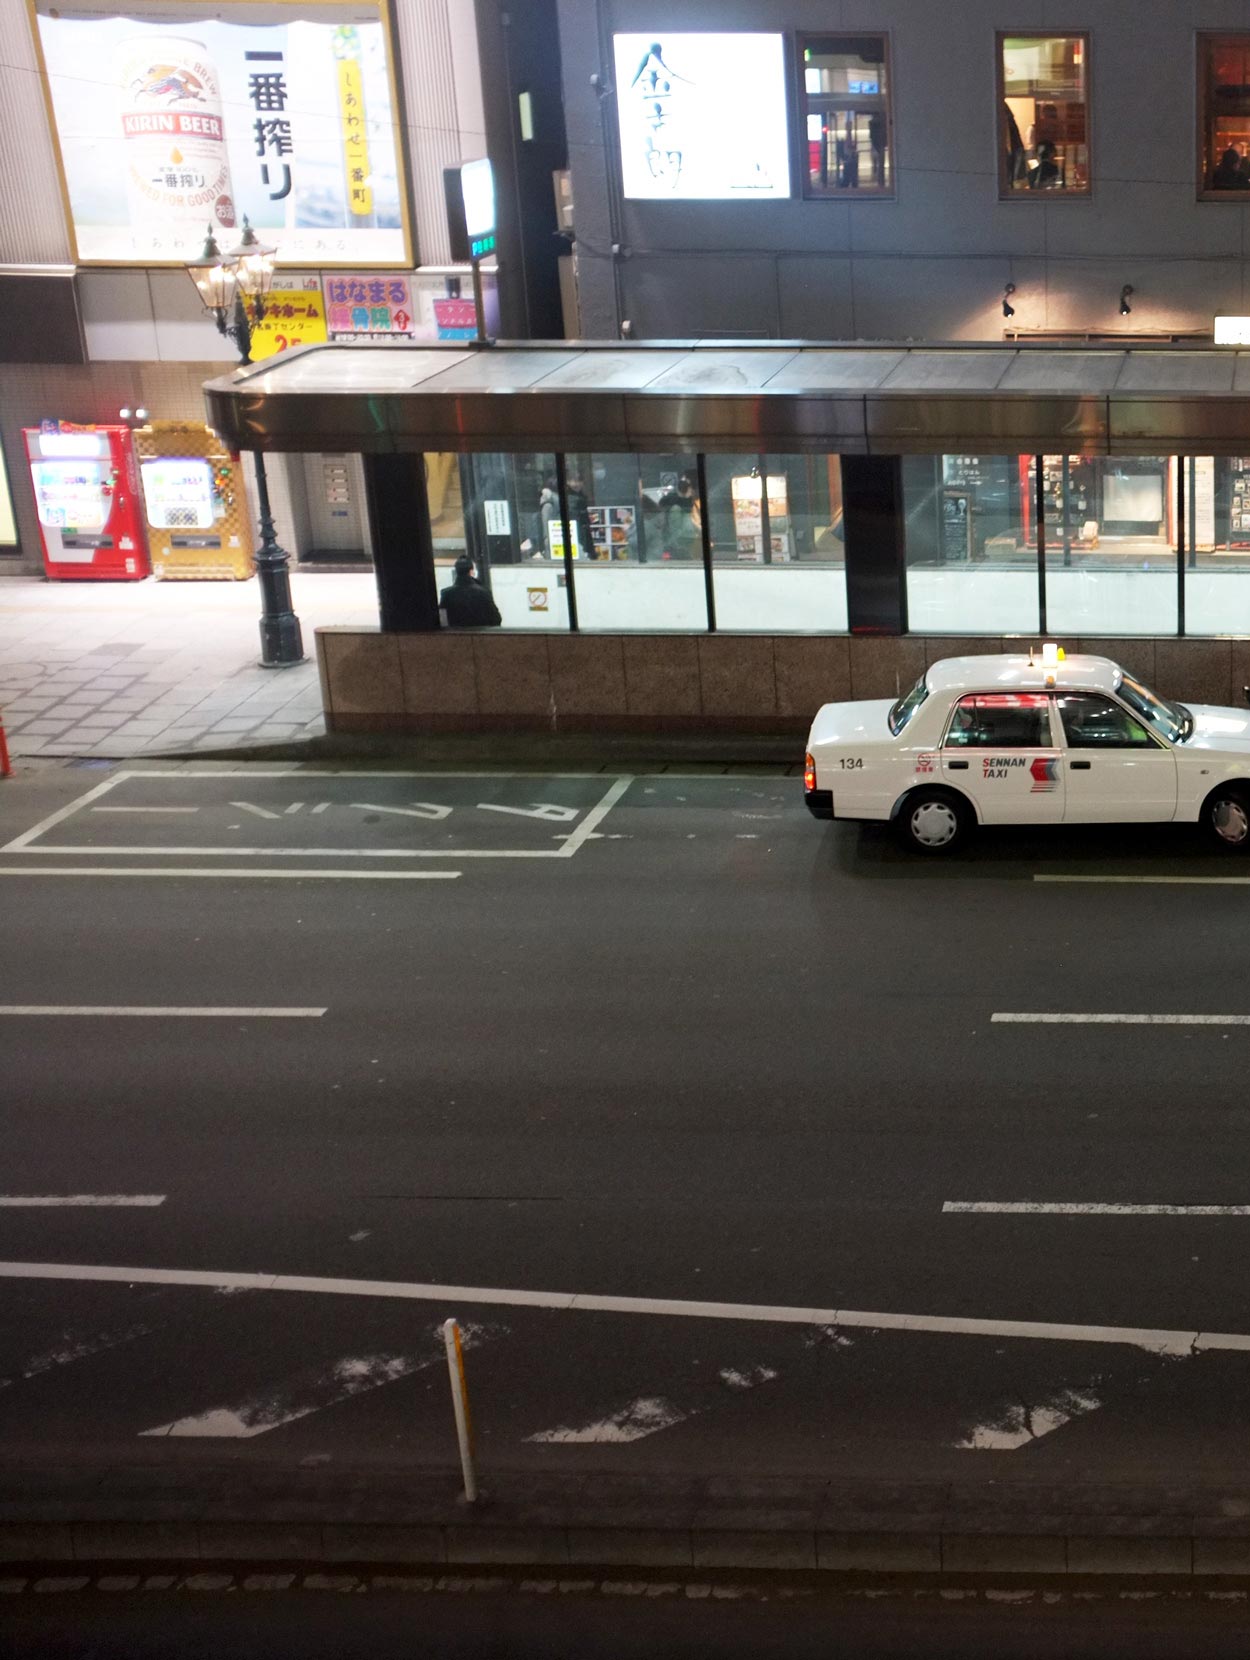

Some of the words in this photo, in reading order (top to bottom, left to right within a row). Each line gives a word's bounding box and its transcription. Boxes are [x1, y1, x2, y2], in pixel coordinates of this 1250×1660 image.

[125, 115, 174, 133] KIRIN
[179, 116, 221, 136] BEER
[244, 50, 293, 201] 一番搾り
[343, 72, 368, 204] しあわせ一番町
[152, 174, 205, 188] 一番搾り
[187, 189, 215, 207] GOOD
[329, 279, 406, 304] はなまる
[839, 758, 863, 769] 134
[982, 758, 1026, 767] SENNAN
[983, 769, 1008, 778] TAXI
